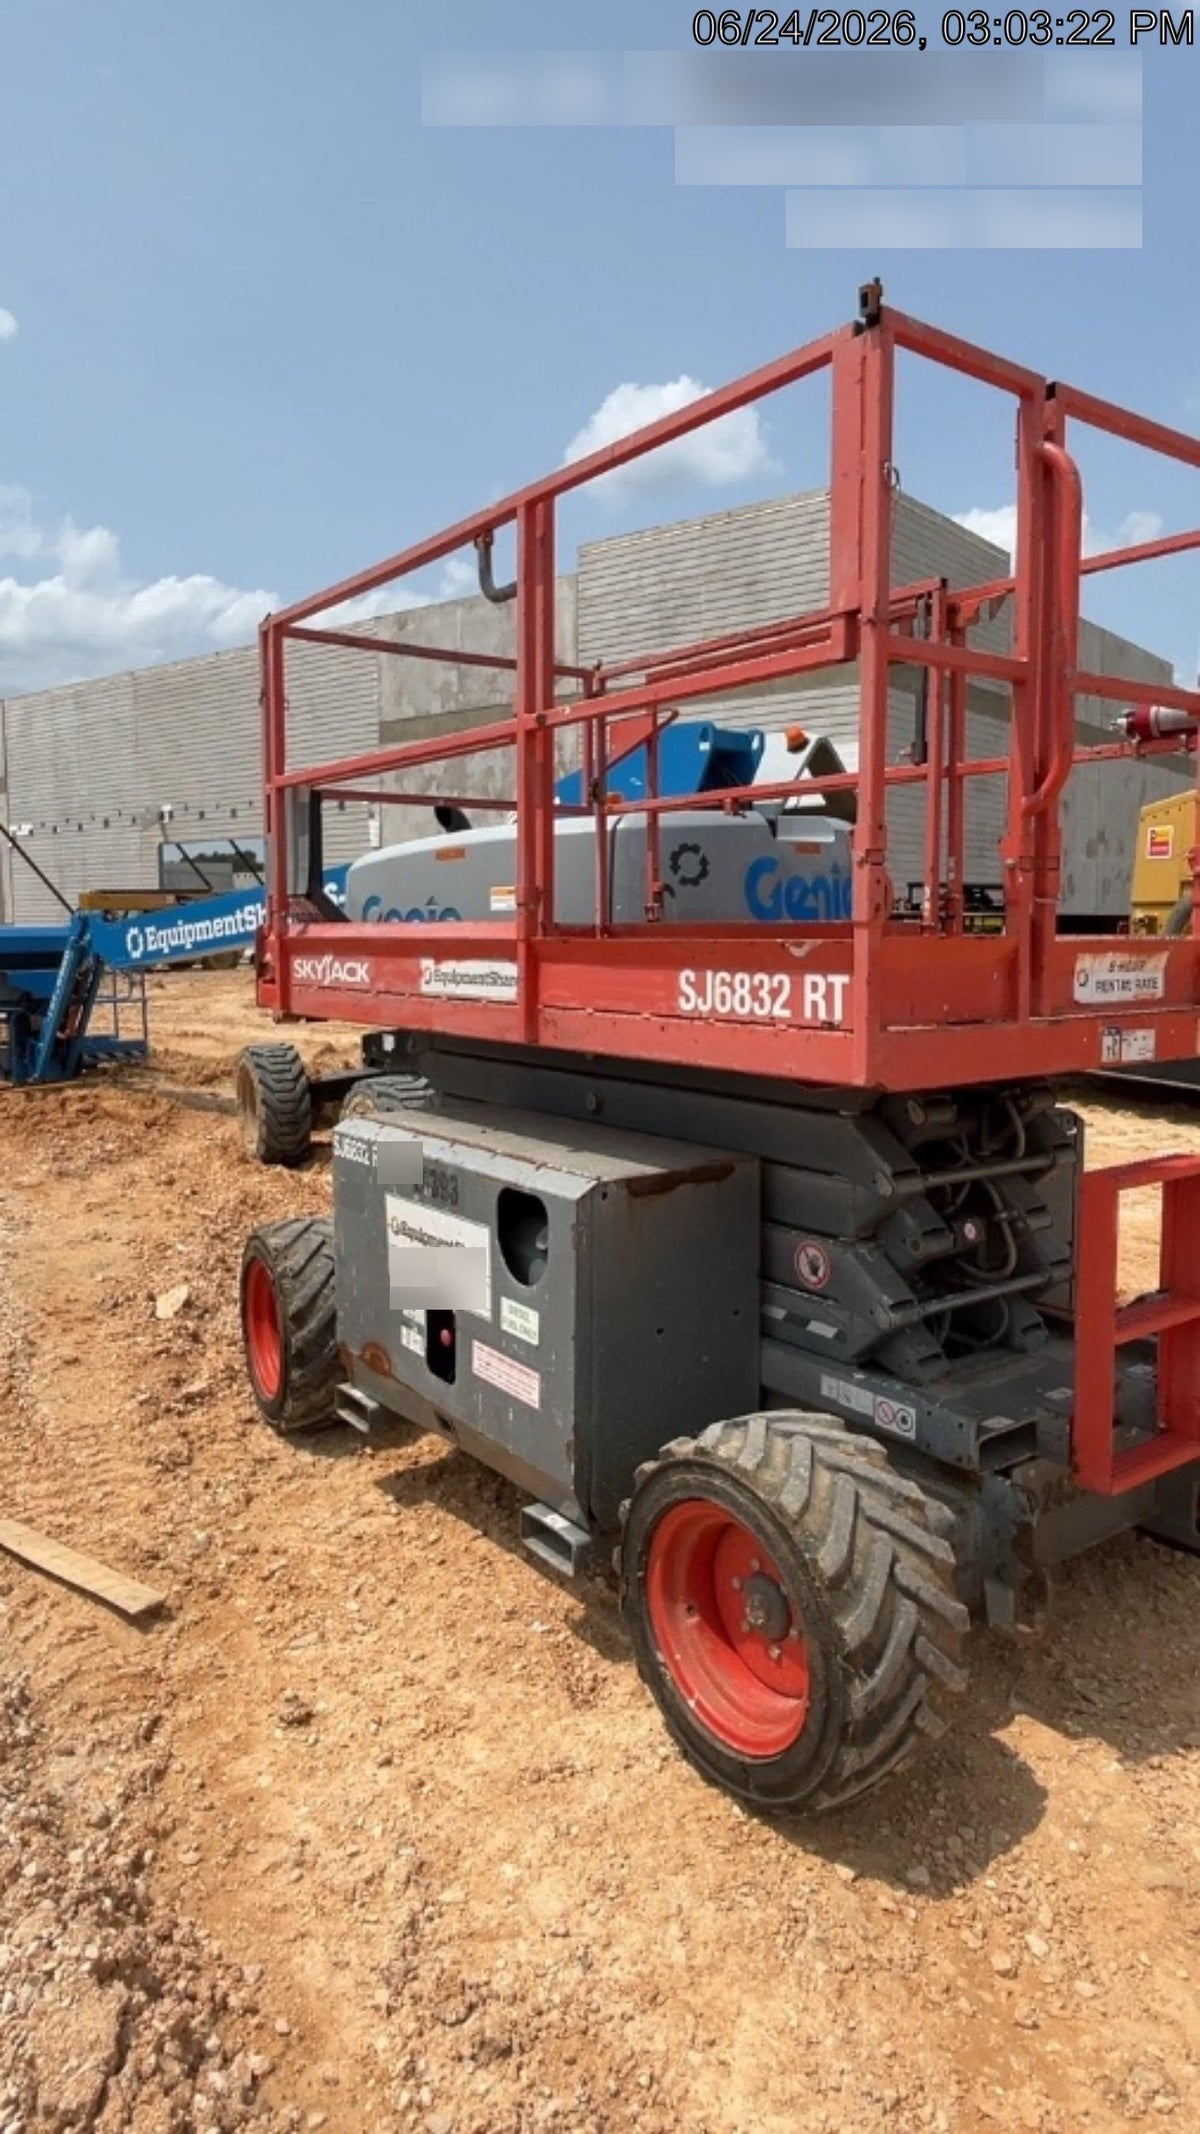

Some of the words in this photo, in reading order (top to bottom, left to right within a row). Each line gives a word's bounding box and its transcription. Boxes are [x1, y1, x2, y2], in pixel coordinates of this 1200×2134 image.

[744, 856, 849, 920] Geni
[293, 954, 370, 985] SKYJACK
[433, 967, 517, 988] EquipmentShar
[678, 969, 792, 1018] SJ6832
[803, 973, 850, 1022] RT
